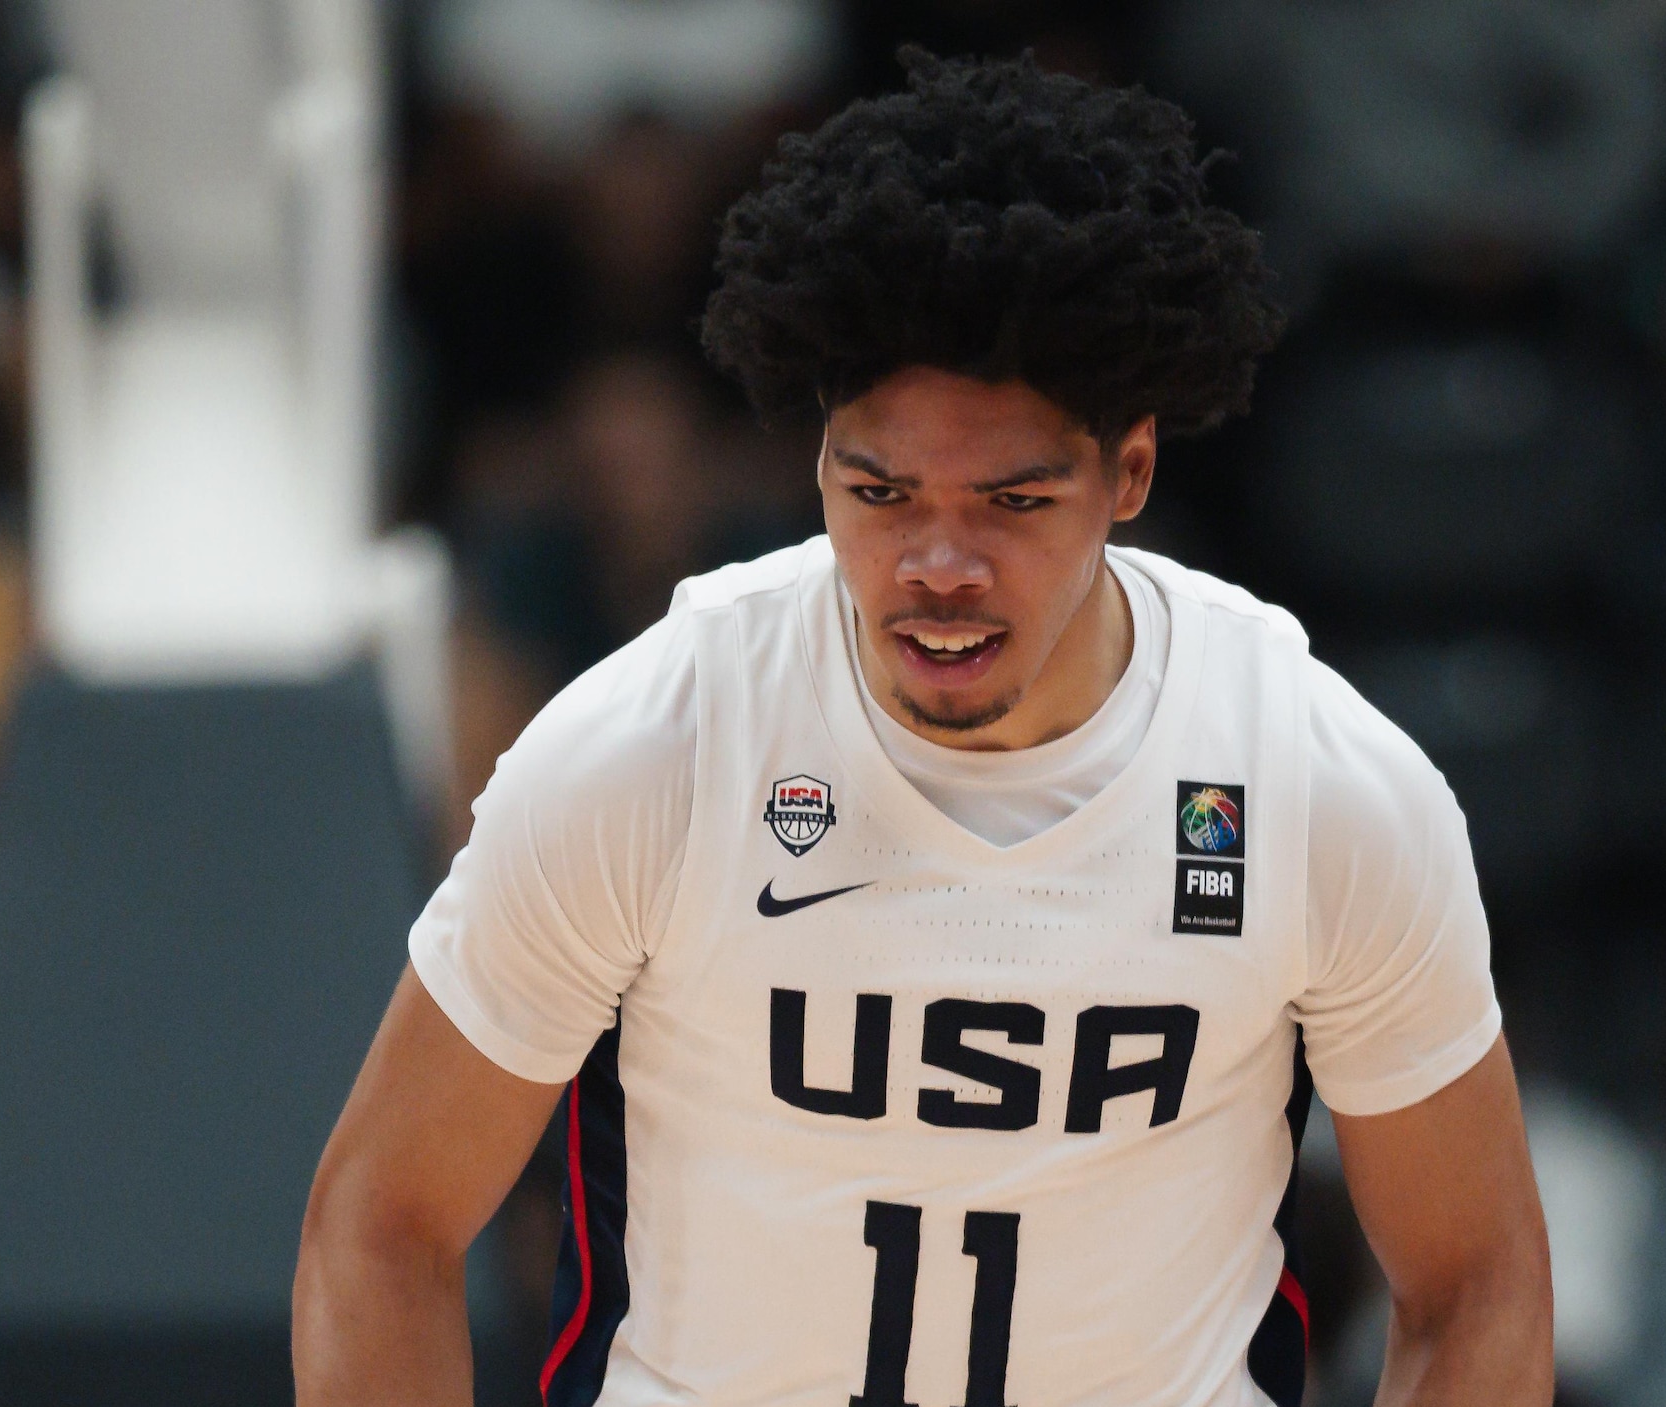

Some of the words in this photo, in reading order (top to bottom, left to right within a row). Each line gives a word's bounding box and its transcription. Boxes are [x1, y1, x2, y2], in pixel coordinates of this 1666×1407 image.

[779, 788, 823, 808] USA
[1186, 869, 1233, 896] FIBA
[770, 987, 1200, 1133] USA
